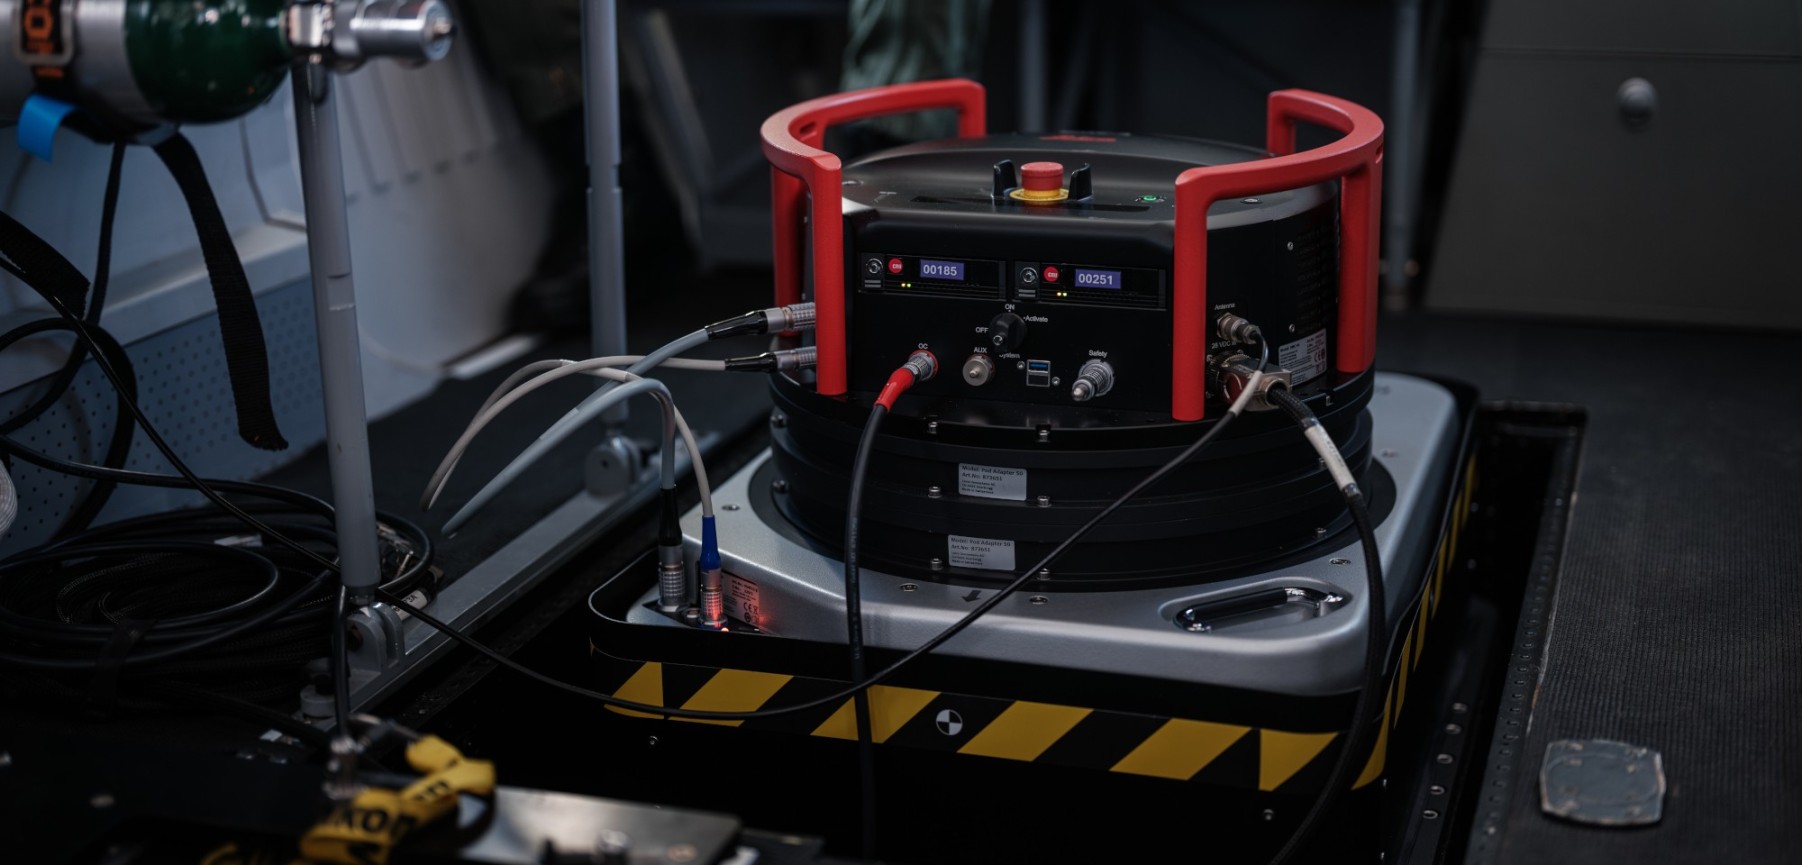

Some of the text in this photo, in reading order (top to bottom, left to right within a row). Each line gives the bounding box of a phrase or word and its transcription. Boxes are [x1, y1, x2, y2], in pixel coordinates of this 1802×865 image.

[923, 264, 957, 276] 00185
[1078, 273, 1113, 285] 00251
[975, 326, 989, 334] OFF
[973, 346, 988, 354] AUX
[1088, 349, 1108, 358] Safety
